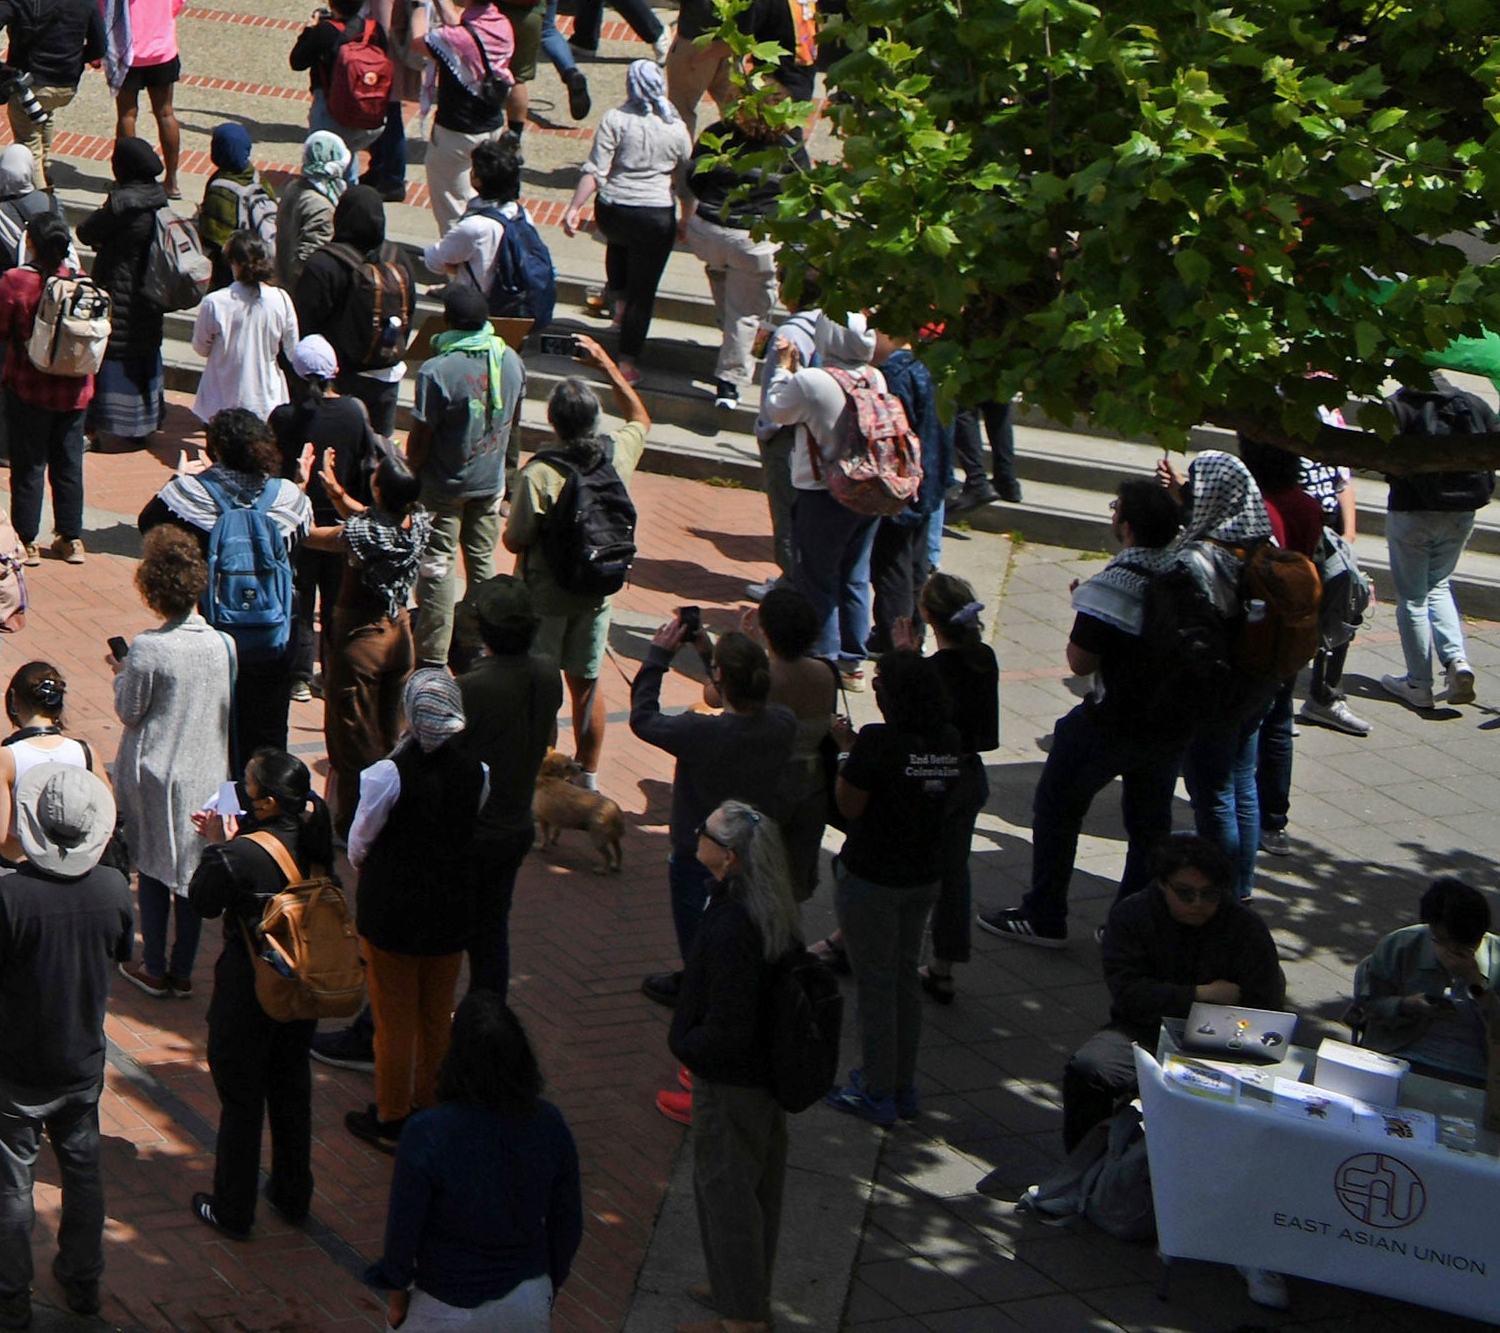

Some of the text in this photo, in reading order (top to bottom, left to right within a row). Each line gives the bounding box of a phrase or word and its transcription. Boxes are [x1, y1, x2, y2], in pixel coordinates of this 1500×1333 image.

[909, 754, 929, 764] End
[905, 767, 960, 777] Colonialism
[1273, 1212, 1486, 1276] EAST ASIAN UNION
